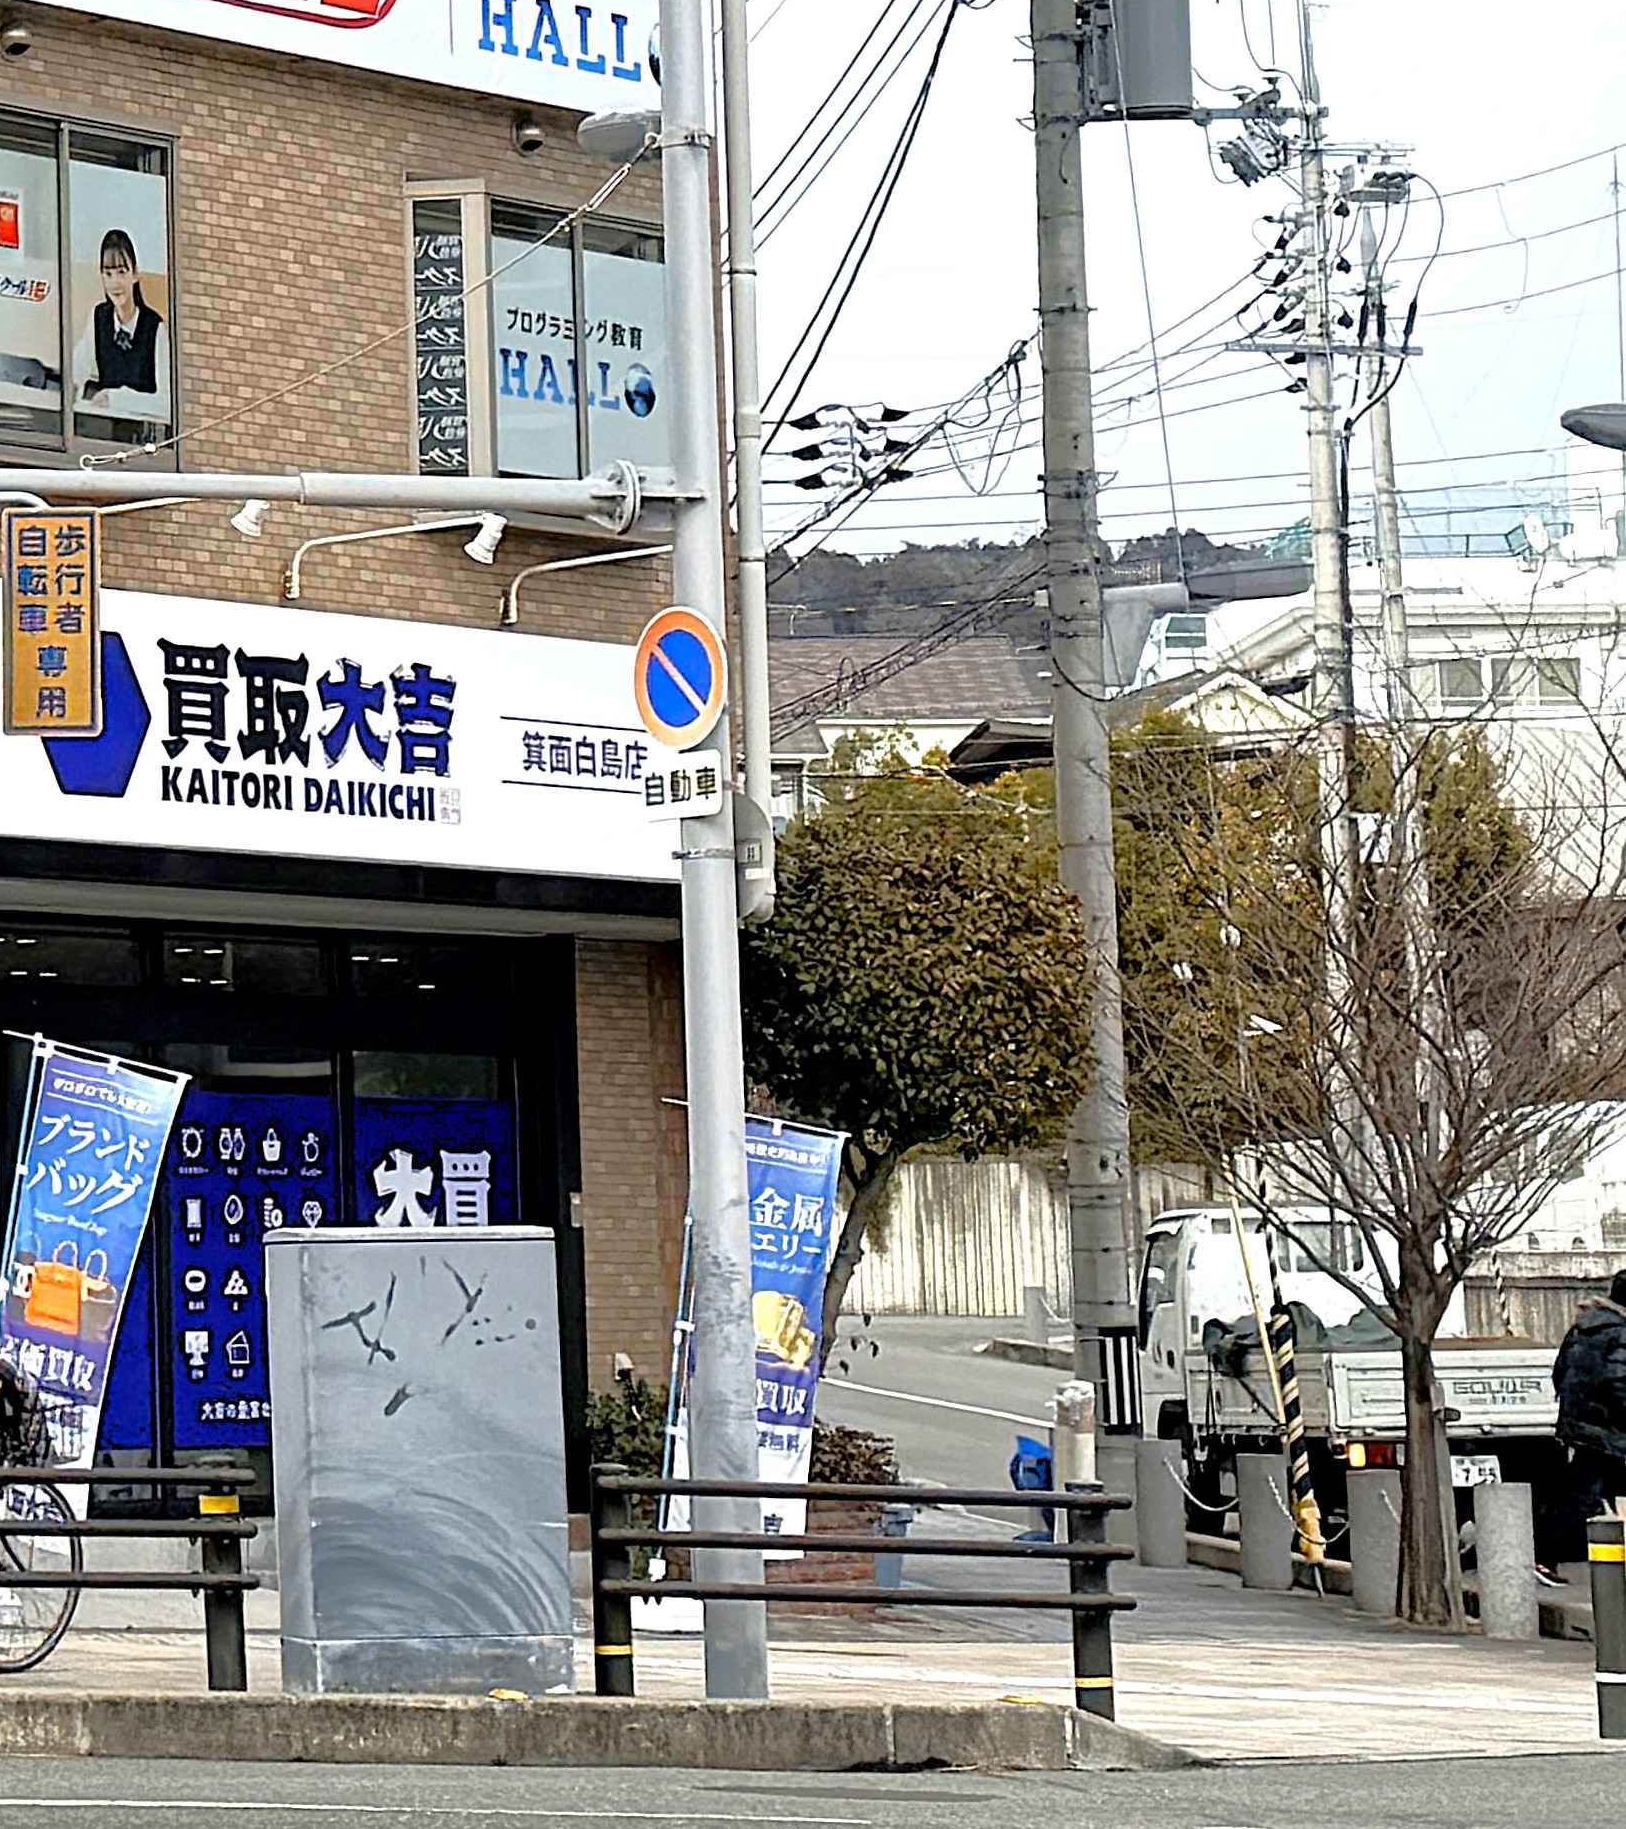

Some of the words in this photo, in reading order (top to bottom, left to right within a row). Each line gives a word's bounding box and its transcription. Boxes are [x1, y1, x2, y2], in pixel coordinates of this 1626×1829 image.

[16, 525, 48, 634] 自転車
[54, 525, 86, 634] 歩行者
[35, 645, 67, 718] 専用
[158, 637, 458, 778] 買取大吉
[522, 730, 647, 784] 箕面白島店
[161, 765, 294, 810] KAITORI
[304, 776, 436, 822] DAIKICHI
[645, 767, 717, 807] 自動車
[37, 1114, 151, 1171] ブランド
[26, 1156, 144, 1215] バッグ
[373, 1148, 438, 1227] 大
[440, 1150, 492, 1226] 買
[750, 1186, 825, 1238] 金属
[751, 1233, 821, 1259] エリー
